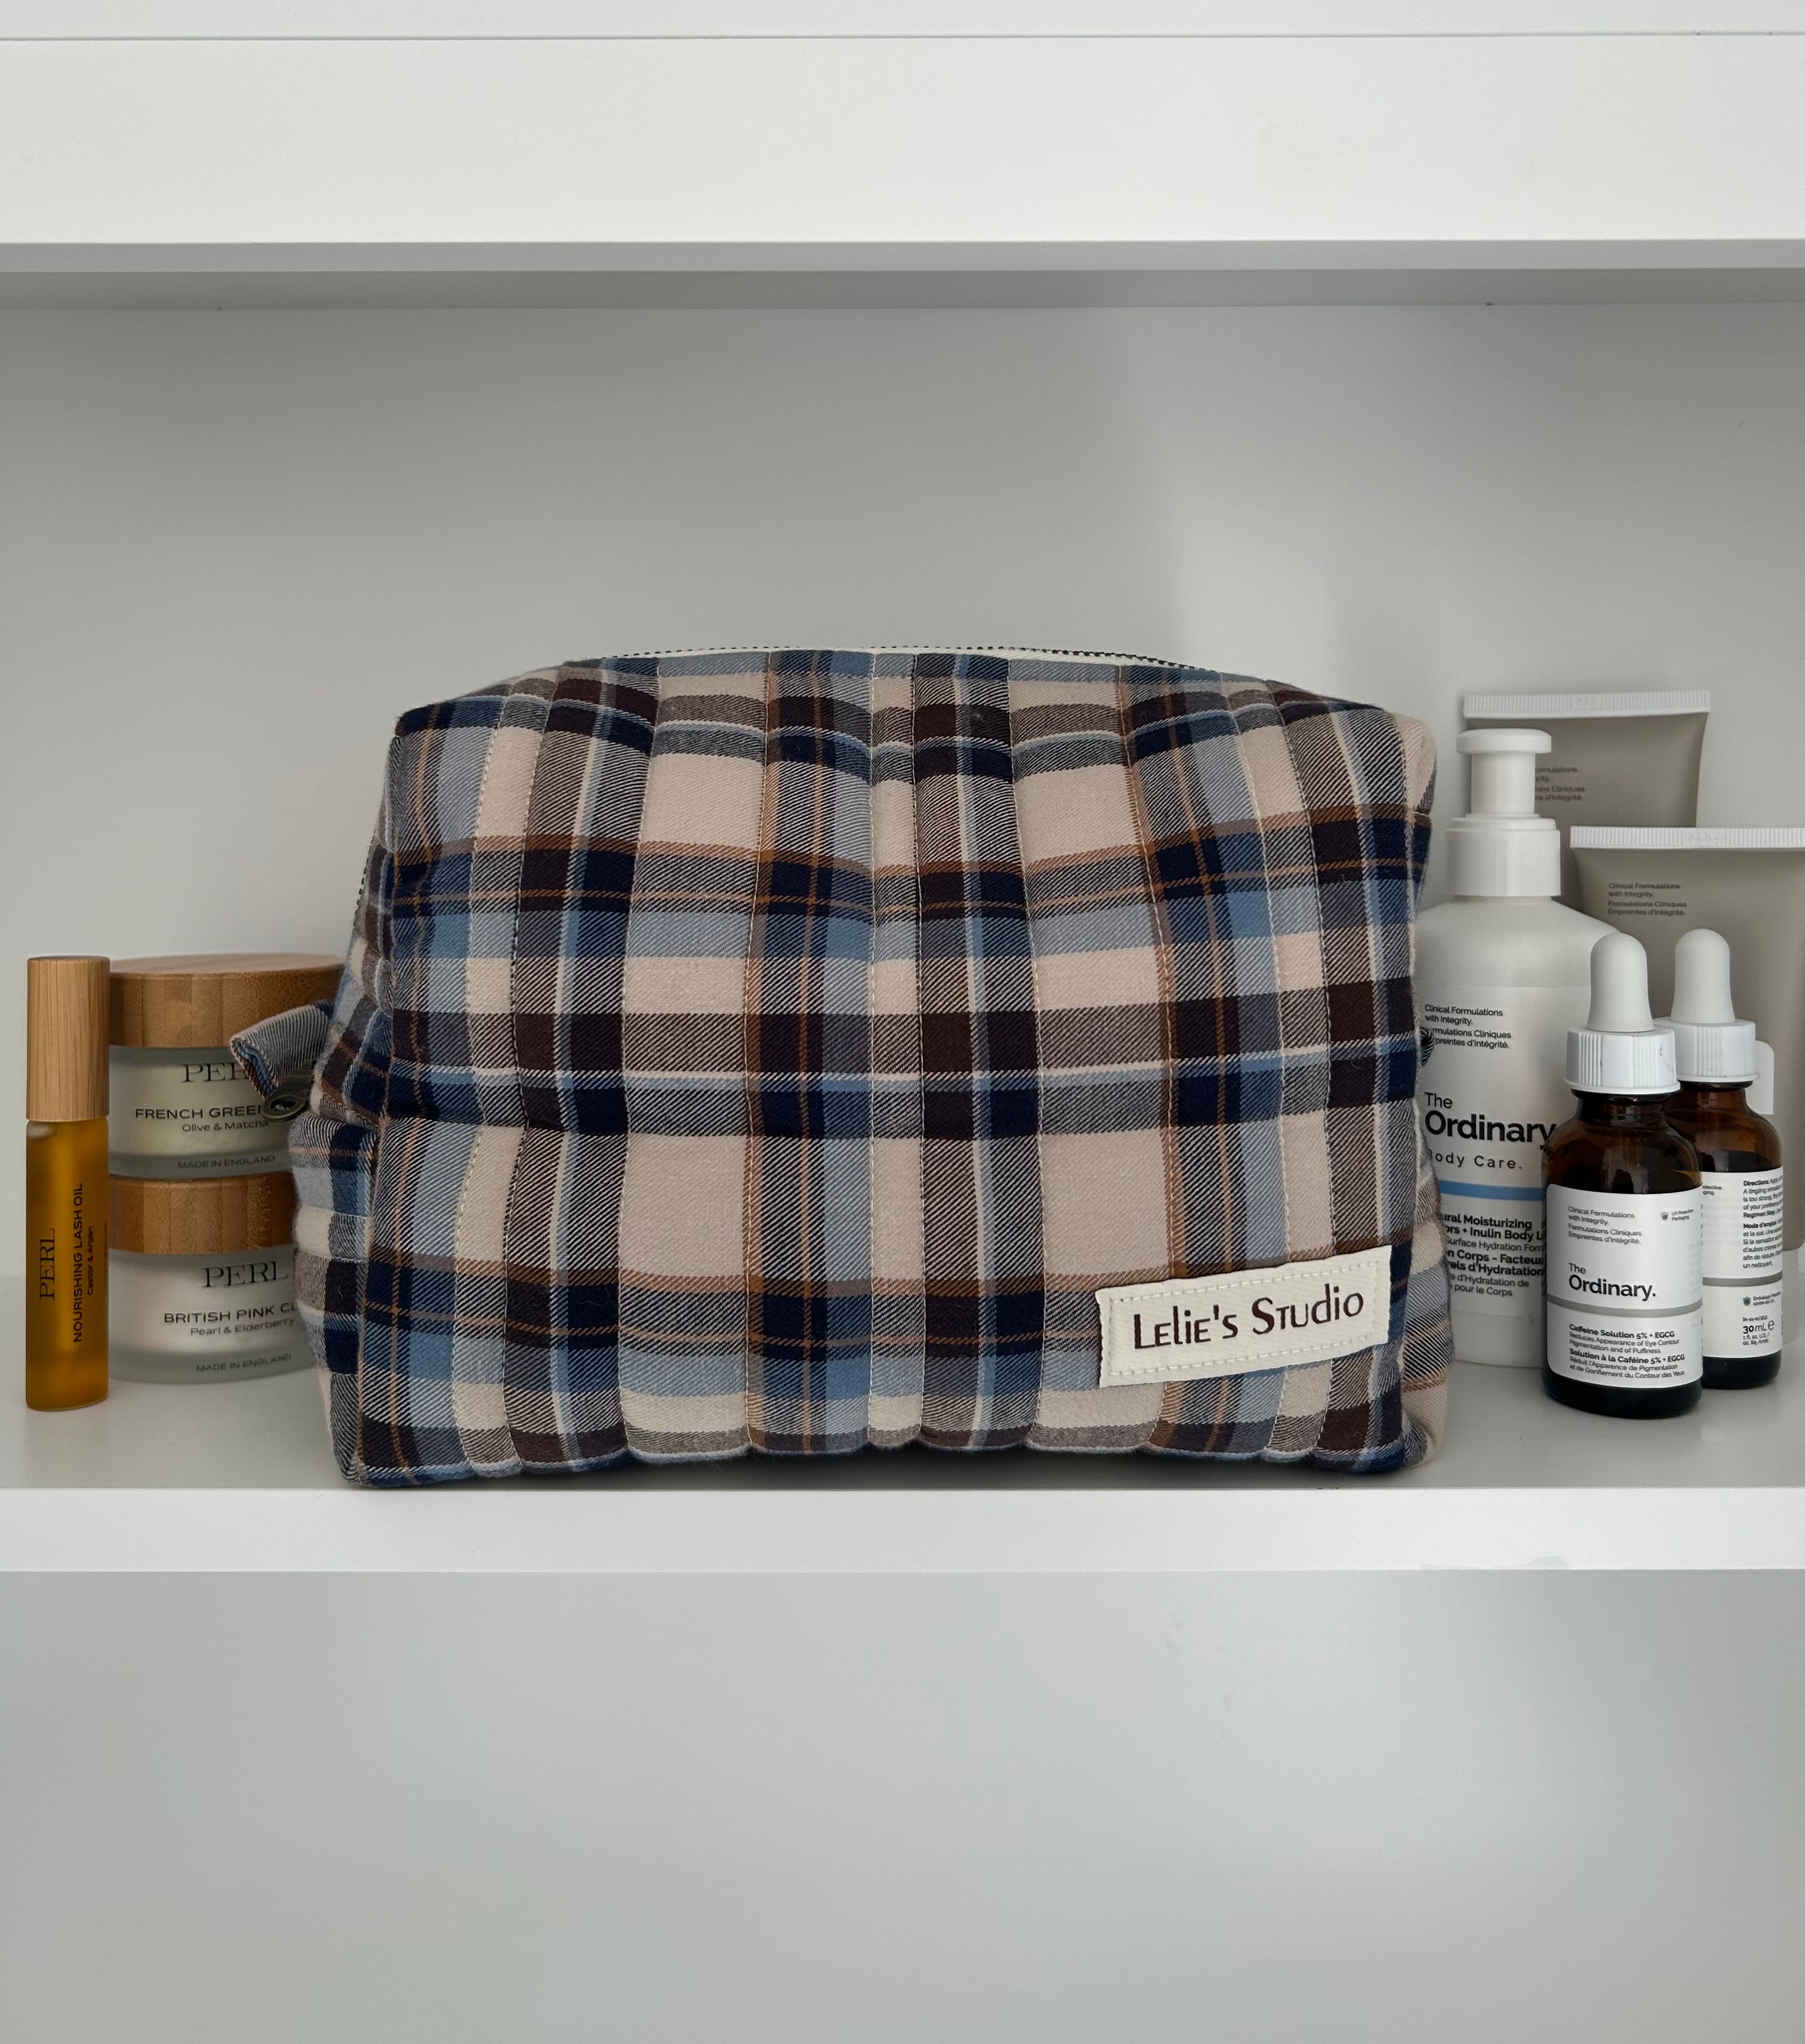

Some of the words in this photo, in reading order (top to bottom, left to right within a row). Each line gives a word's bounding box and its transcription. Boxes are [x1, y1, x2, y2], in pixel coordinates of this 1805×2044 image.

[1425, 1004, 1450, 1014] Clinical
[1451, 1006, 1503, 1016] Formulations
[1441, 1016, 1473, 1026] Integrity.
[1433, 1027, 1472, 1037] rmulations
[1474, 1030, 1511, 1039] Cliniques
[1435, 1038, 1465, 1046] preintes
[1424, 1092, 1453, 1109] The
[135, 1109, 204, 1119] FRENCH
[182, 1123, 210, 1132] Olive
[225, 1120, 269, 1130] Matcha
[178, 1159, 209, 1169] MADE
[211, 1159, 221, 1168] IN
[224, 1155, 275, 1167] ENGLAND
[1430, 1150, 1465, 1168] ody
[1474, 1155, 1522, 1169] Care.
[73, 1183, 83, 1206] OIL
[1568, 1206, 1589, 1215] Clinical
[1590, 1209, 1635, 1218] Formulations
[73, 1210, 83, 1249] LASH
[1464, 1214, 1532, 1231] Moisturizing
[1470, 1227, 1501, 1239] Inulin
[1505, 1230, 1533, 1242] Body
[1569, 1223, 1609, 1235] Formulations
[1610, 1229, 1642, 1237] Cliniques
[1569, 1231, 1603, 1242] Empreintes
[1479, 1240, 1521, 1252] Hydration
[1457, 1249, 1490, 1265] Corps
[39, 1228, 55, 1301] PERL
[1569, 1263, 1586, 1275] The
[200, 1260, 289, 1288] PERL
[1457, 1273, 1515, 1286] d'Hydratation
[1455, 1284, 1474, 1294] pour
[1476, 1285, 1484, 1294] le
[1486, 1287, 1513, 1297] Corps
[1569, 1274, 1656, 1301] Ordinary.
[73, 1252, 83, 1343] NOURISHING
[164, 1311, 231, 1323] BRITISH
[236, 1305, 275, 1320] PINK
[1134, 1304, 1239, 1349] Lelie's
[1252, 1283, 1364, 1335] Studio
[190, 1326, 221, 1337] Pearl
[224, 1326, 232, 1334] &
[235, 1317, 295, 1334] Elderberry
[1569, 1323, 1598, 1335] Caffeine
[1600, 1329, 1634, 1339] Solution
[1569, 1332, 1594, 1342] Reduces
[1595, 1337, 1637, 1346] Appearance
[1569, 1338, 1609, 1352] Pigmentation
[196, 1362, 227, 1372] MADE
[230, 1361, 240, 1369] IN
[242, 1353, 291, 1368] ENGLAND
[1569, 1348, 1600, 1360] Solution
[1618, 1355, 1649, 1364] Caféine
[1650, 1356, 1661, 1365] 5%
[1667, 1353, 1685, 1362] EGCG
[1585, 1367, 1623, 1378] Gonflement
[1639, 1364, 1678, 1372] Pigmentation
